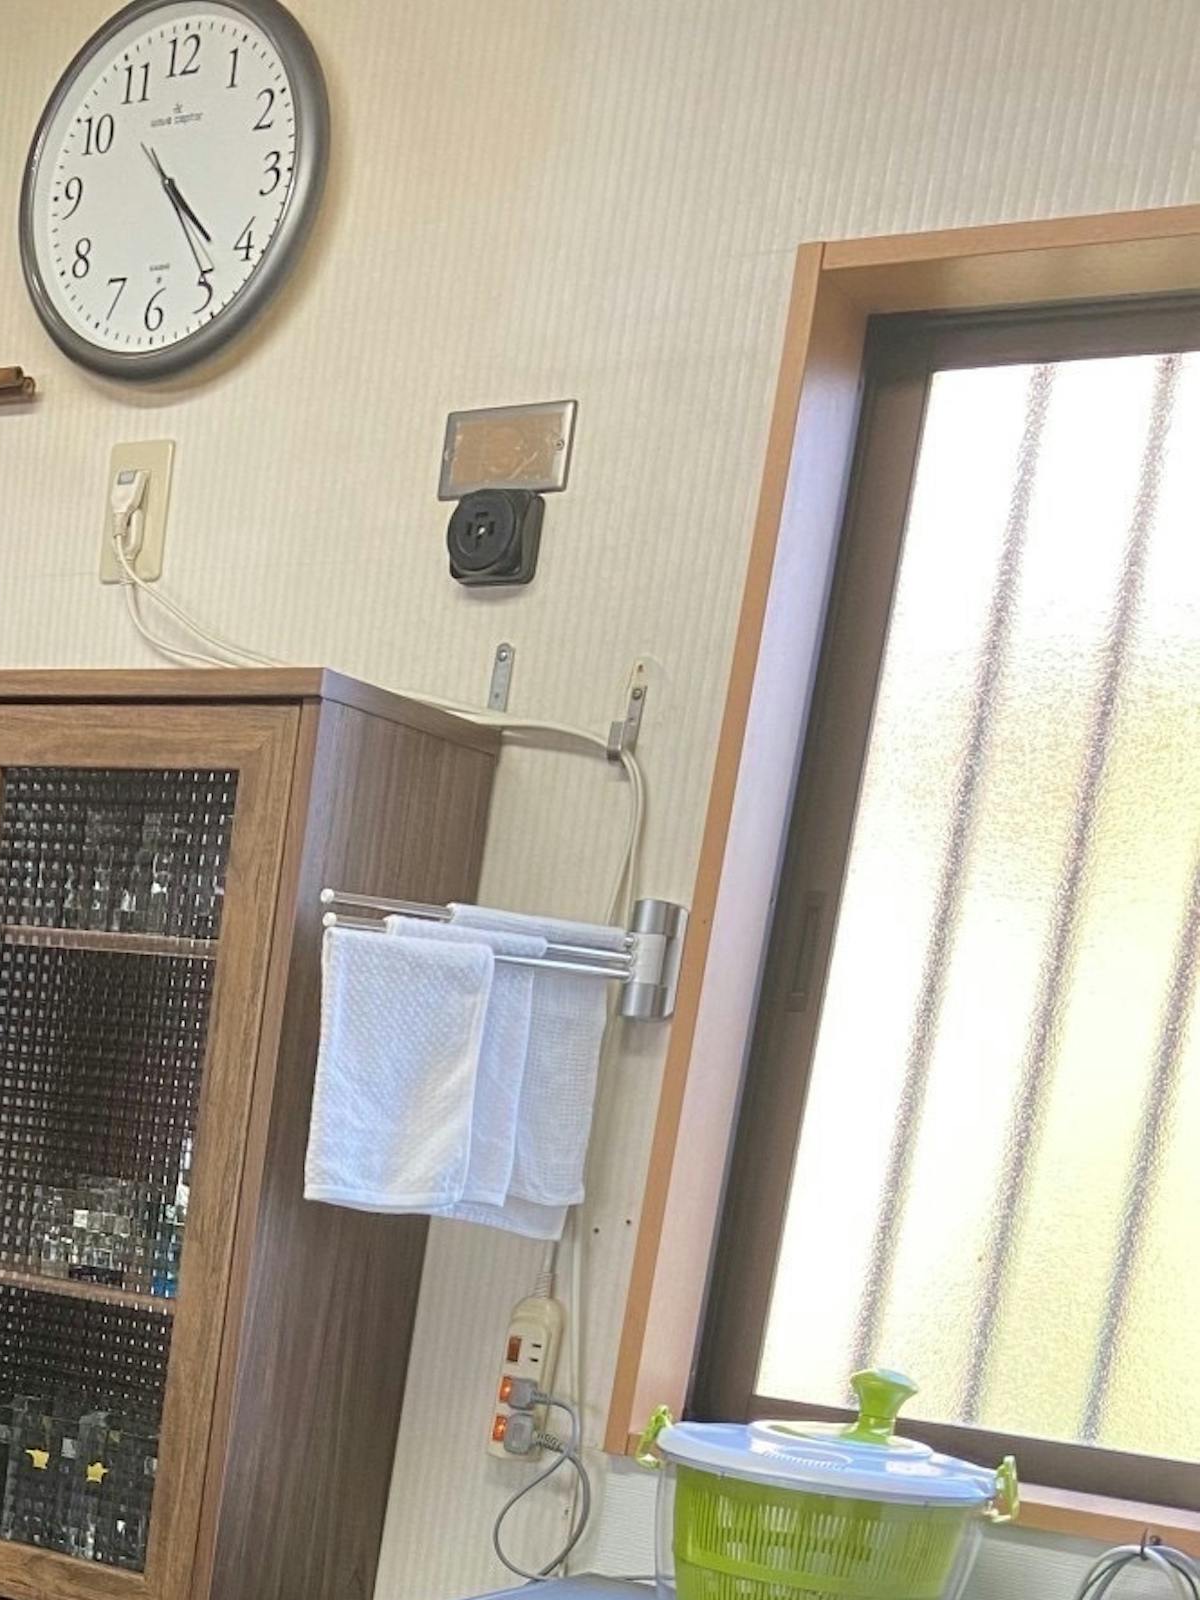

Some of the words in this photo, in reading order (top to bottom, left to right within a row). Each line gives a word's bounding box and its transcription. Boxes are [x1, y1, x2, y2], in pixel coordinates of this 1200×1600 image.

[165, 34, 201, 78] 12
[226, 48, 240, 89] 1
[120, 62, 151, 105] 11
[252, 88, 275, 131] 2
[81, 113, 115, 155] 10
[259, 151, 281, 196] 3
[62, 176, 83, 220] 9
[72, 237, 92, 278] 8
[233, 216, 256, 261] 4
[106, 277, 128, 321] 7
[144, 288, 167, 331] 6
[193, 268, 214, 314] 5
